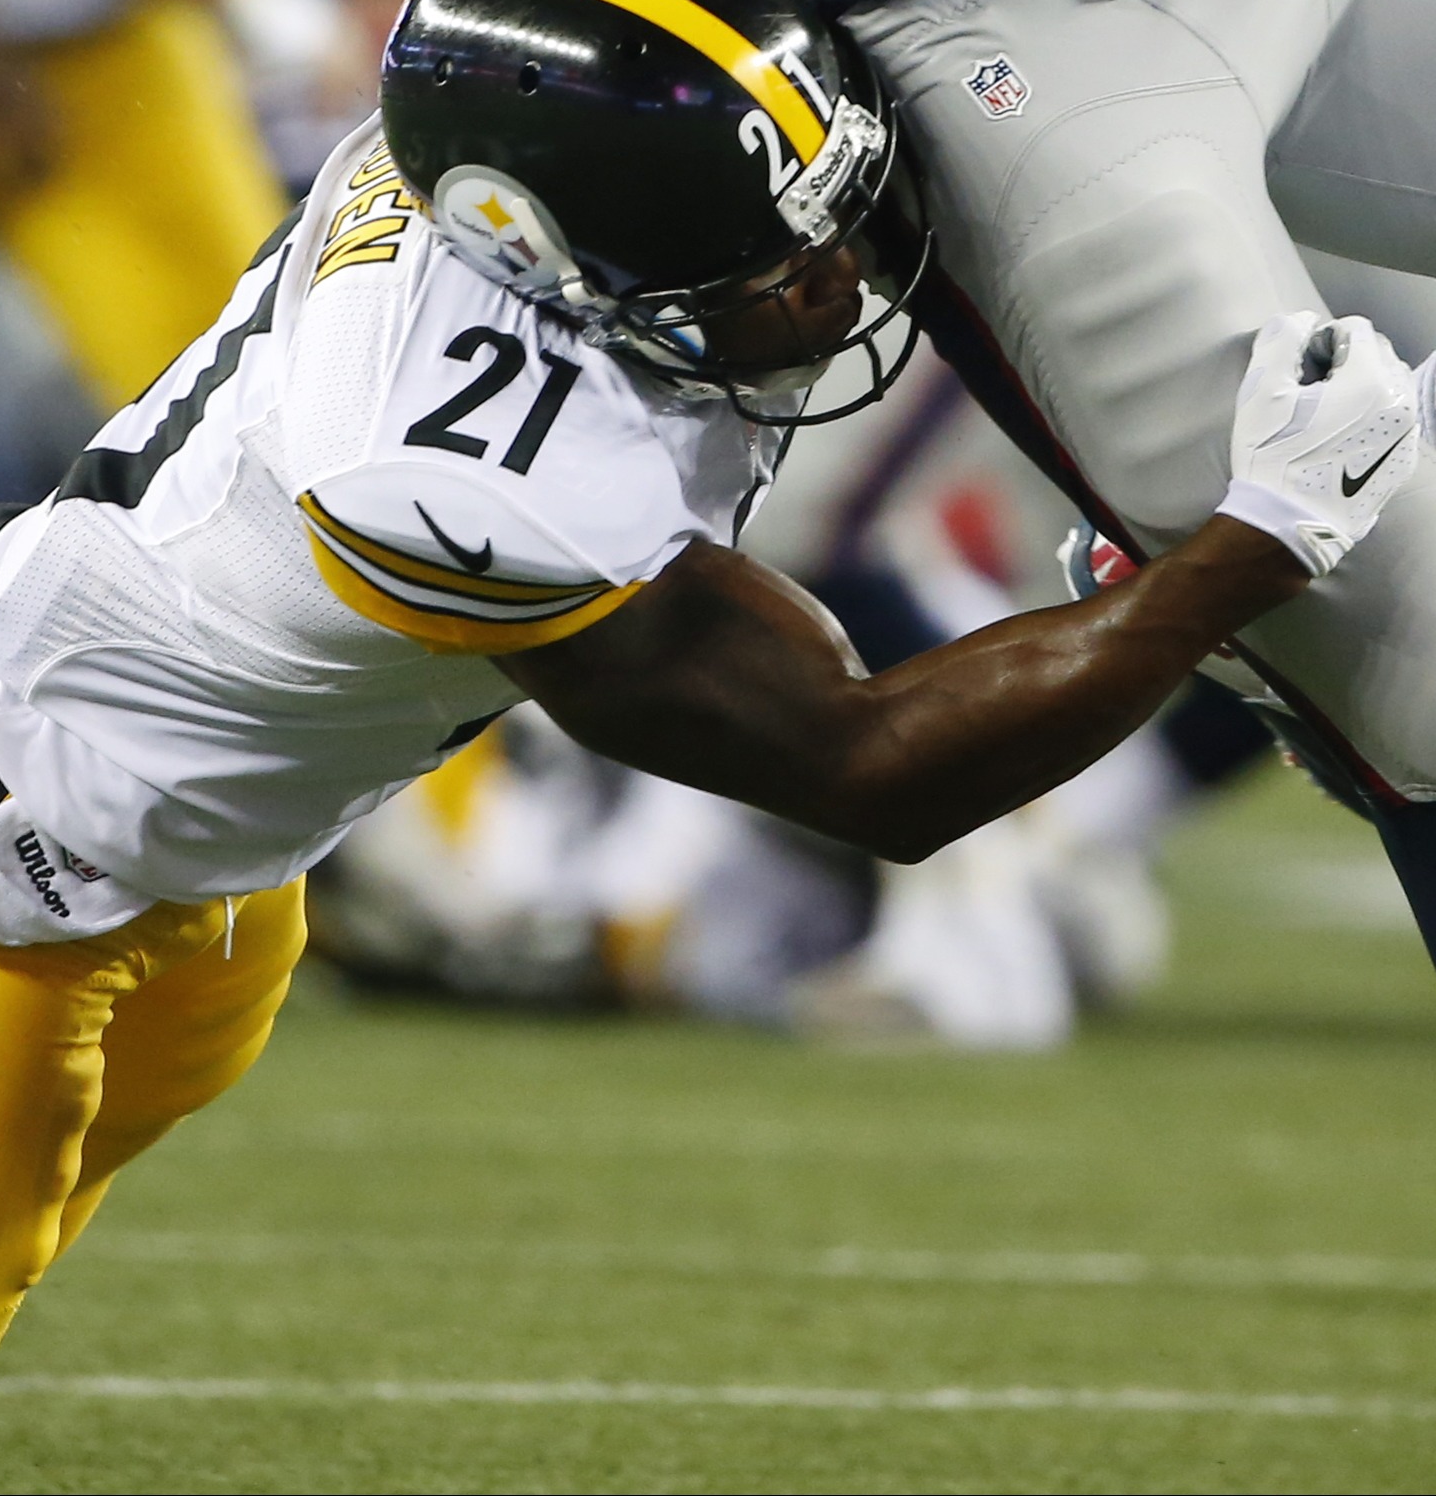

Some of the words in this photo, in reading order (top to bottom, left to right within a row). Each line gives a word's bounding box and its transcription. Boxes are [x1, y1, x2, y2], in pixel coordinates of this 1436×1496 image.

[983, 78, 1024, 112] NFL
[403, 326, 582, 476] 21
[14, 829, 71, 918] Wilson
